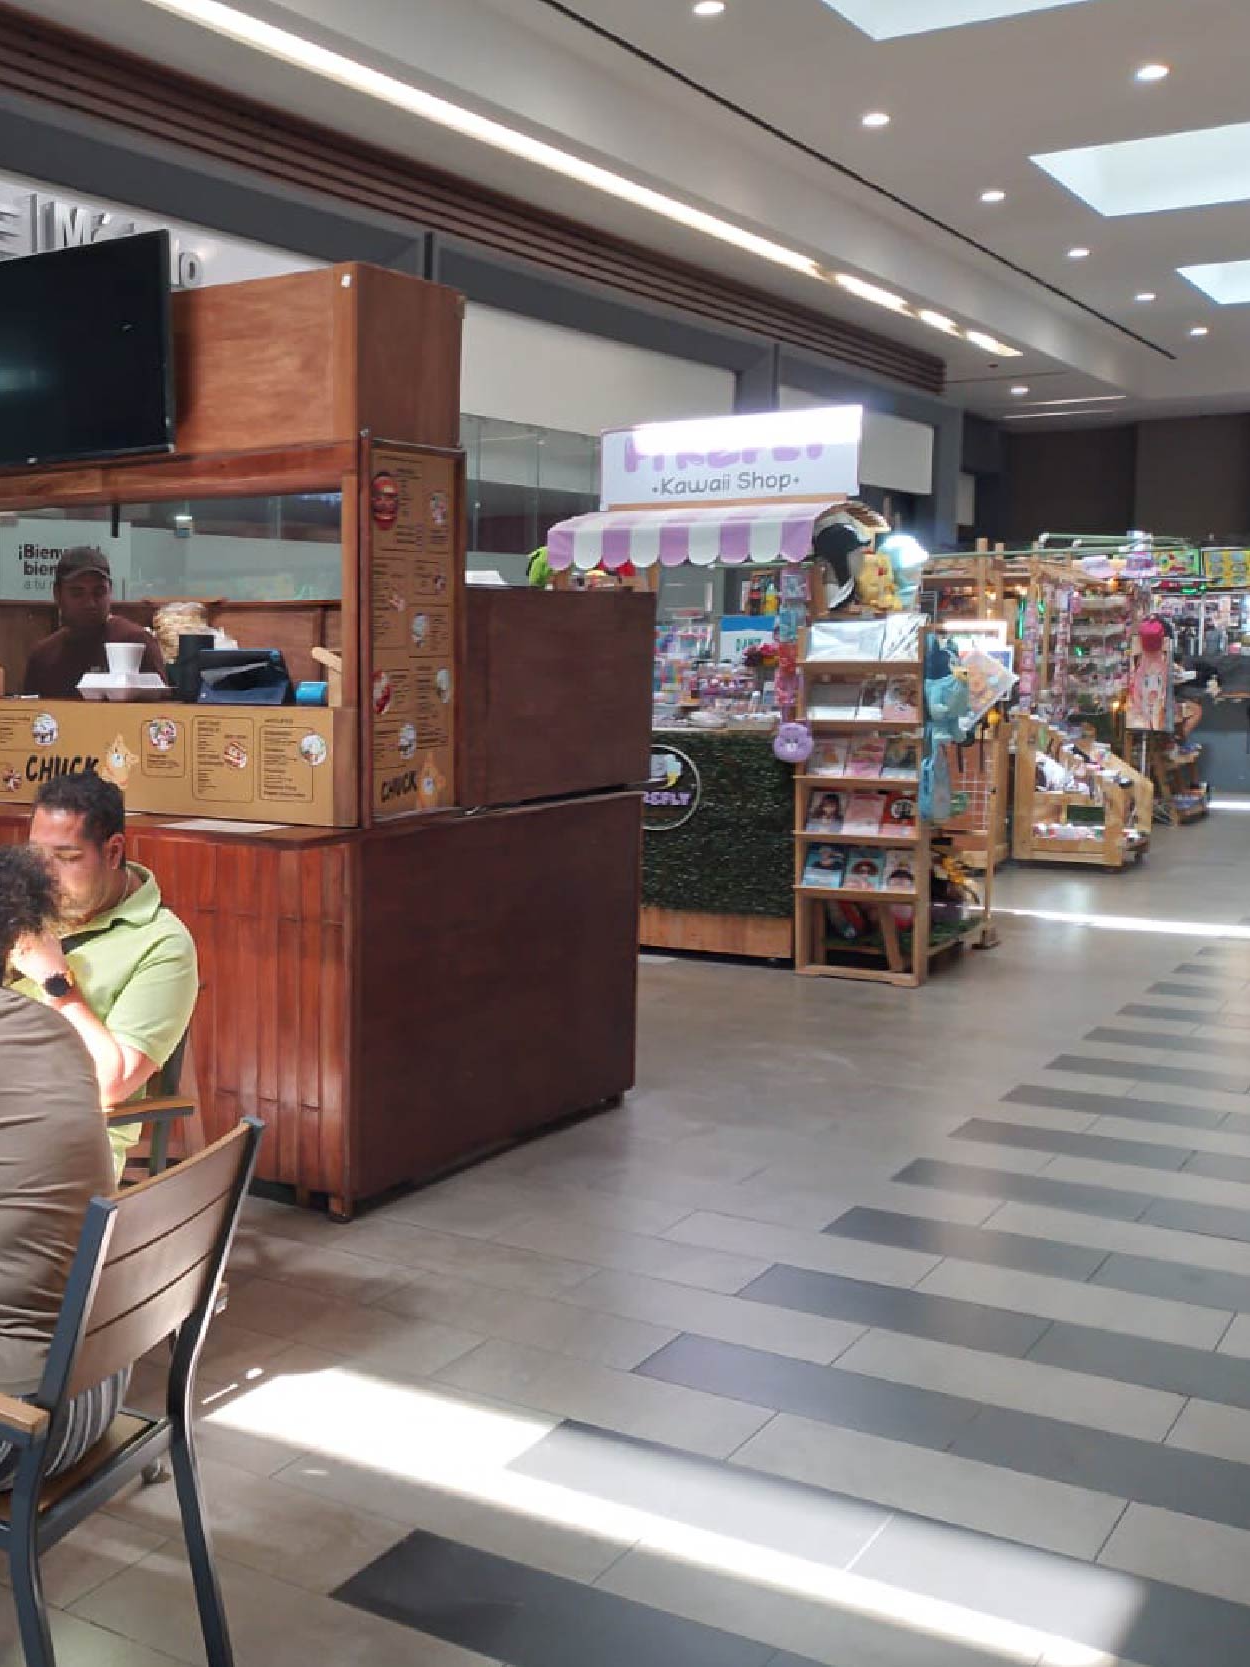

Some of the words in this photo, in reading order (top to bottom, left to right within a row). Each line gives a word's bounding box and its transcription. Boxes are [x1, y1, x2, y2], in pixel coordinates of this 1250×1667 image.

[661, 473, 731, 495] Kawaii
[737, 472, 792, 491] Shop
[25, 754, 100, 783] CHUCK
